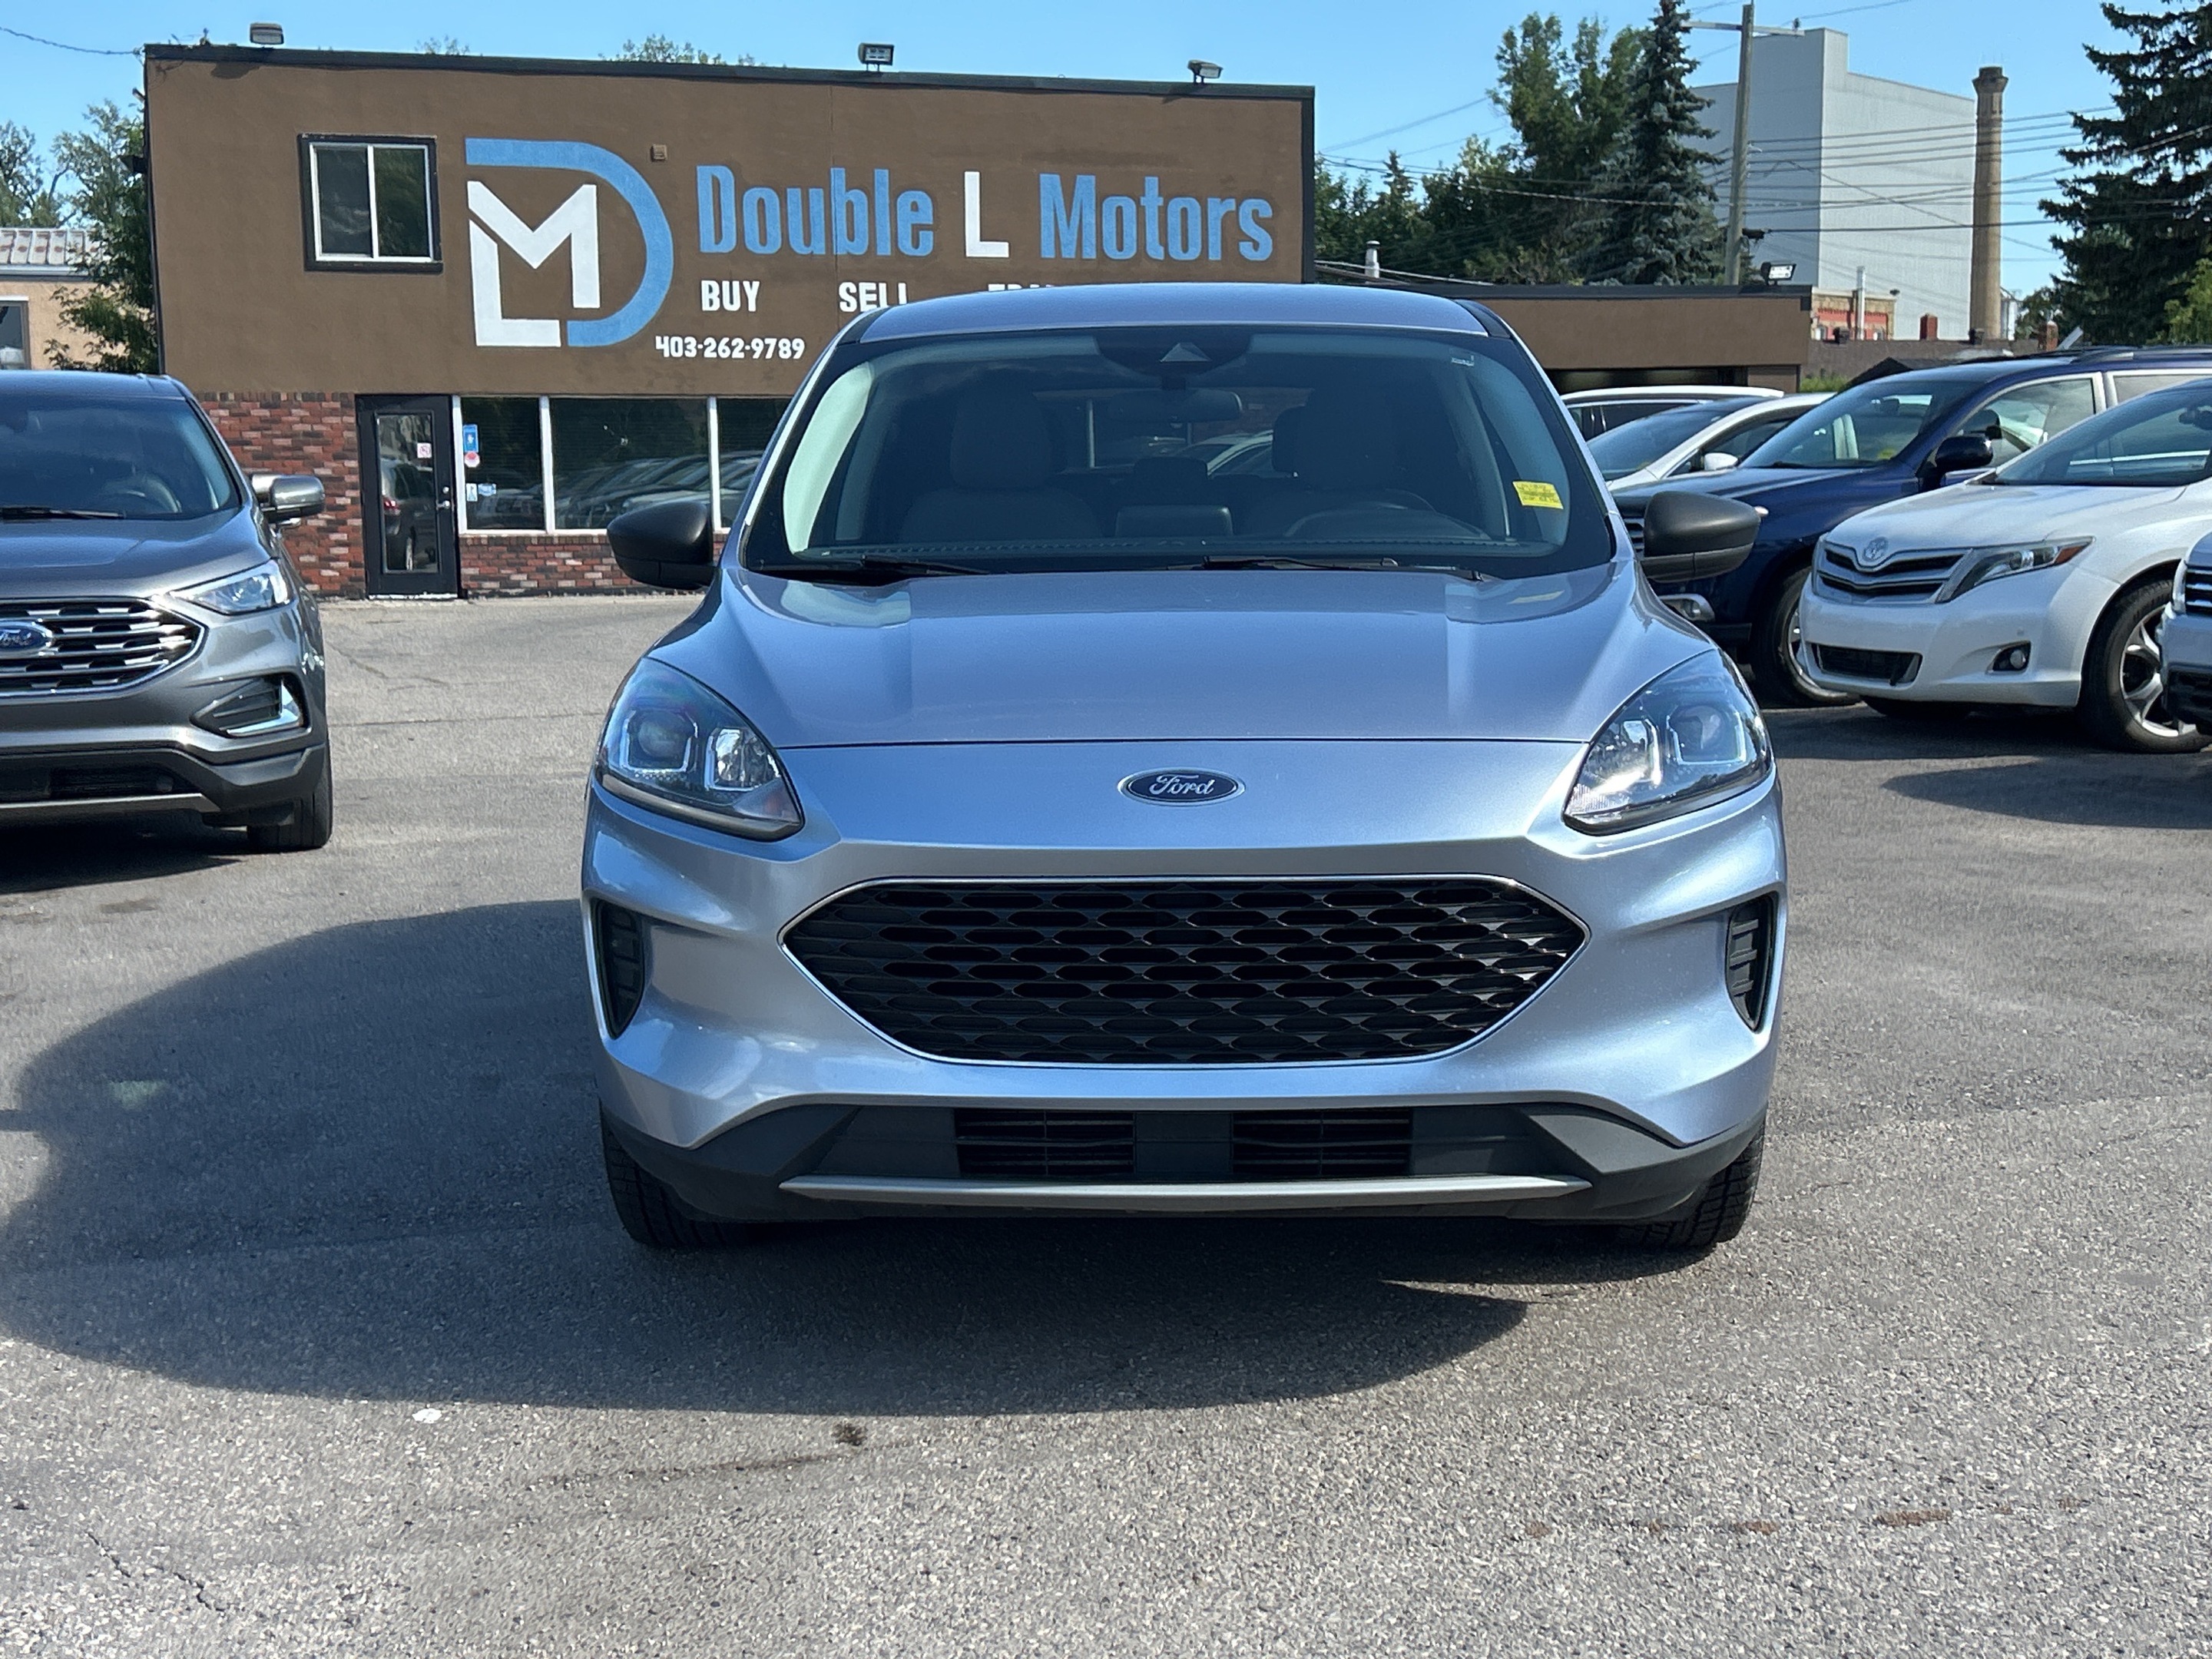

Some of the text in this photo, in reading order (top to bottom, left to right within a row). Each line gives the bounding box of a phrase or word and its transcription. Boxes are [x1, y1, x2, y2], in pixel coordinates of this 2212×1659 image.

[696, 164, 1273, 261] Double L Motors
[700, 280, 760, 313] BUY
[655, 335, 806, 359] 403-262-9789
[1149, 774, 1215, 795] Ford
